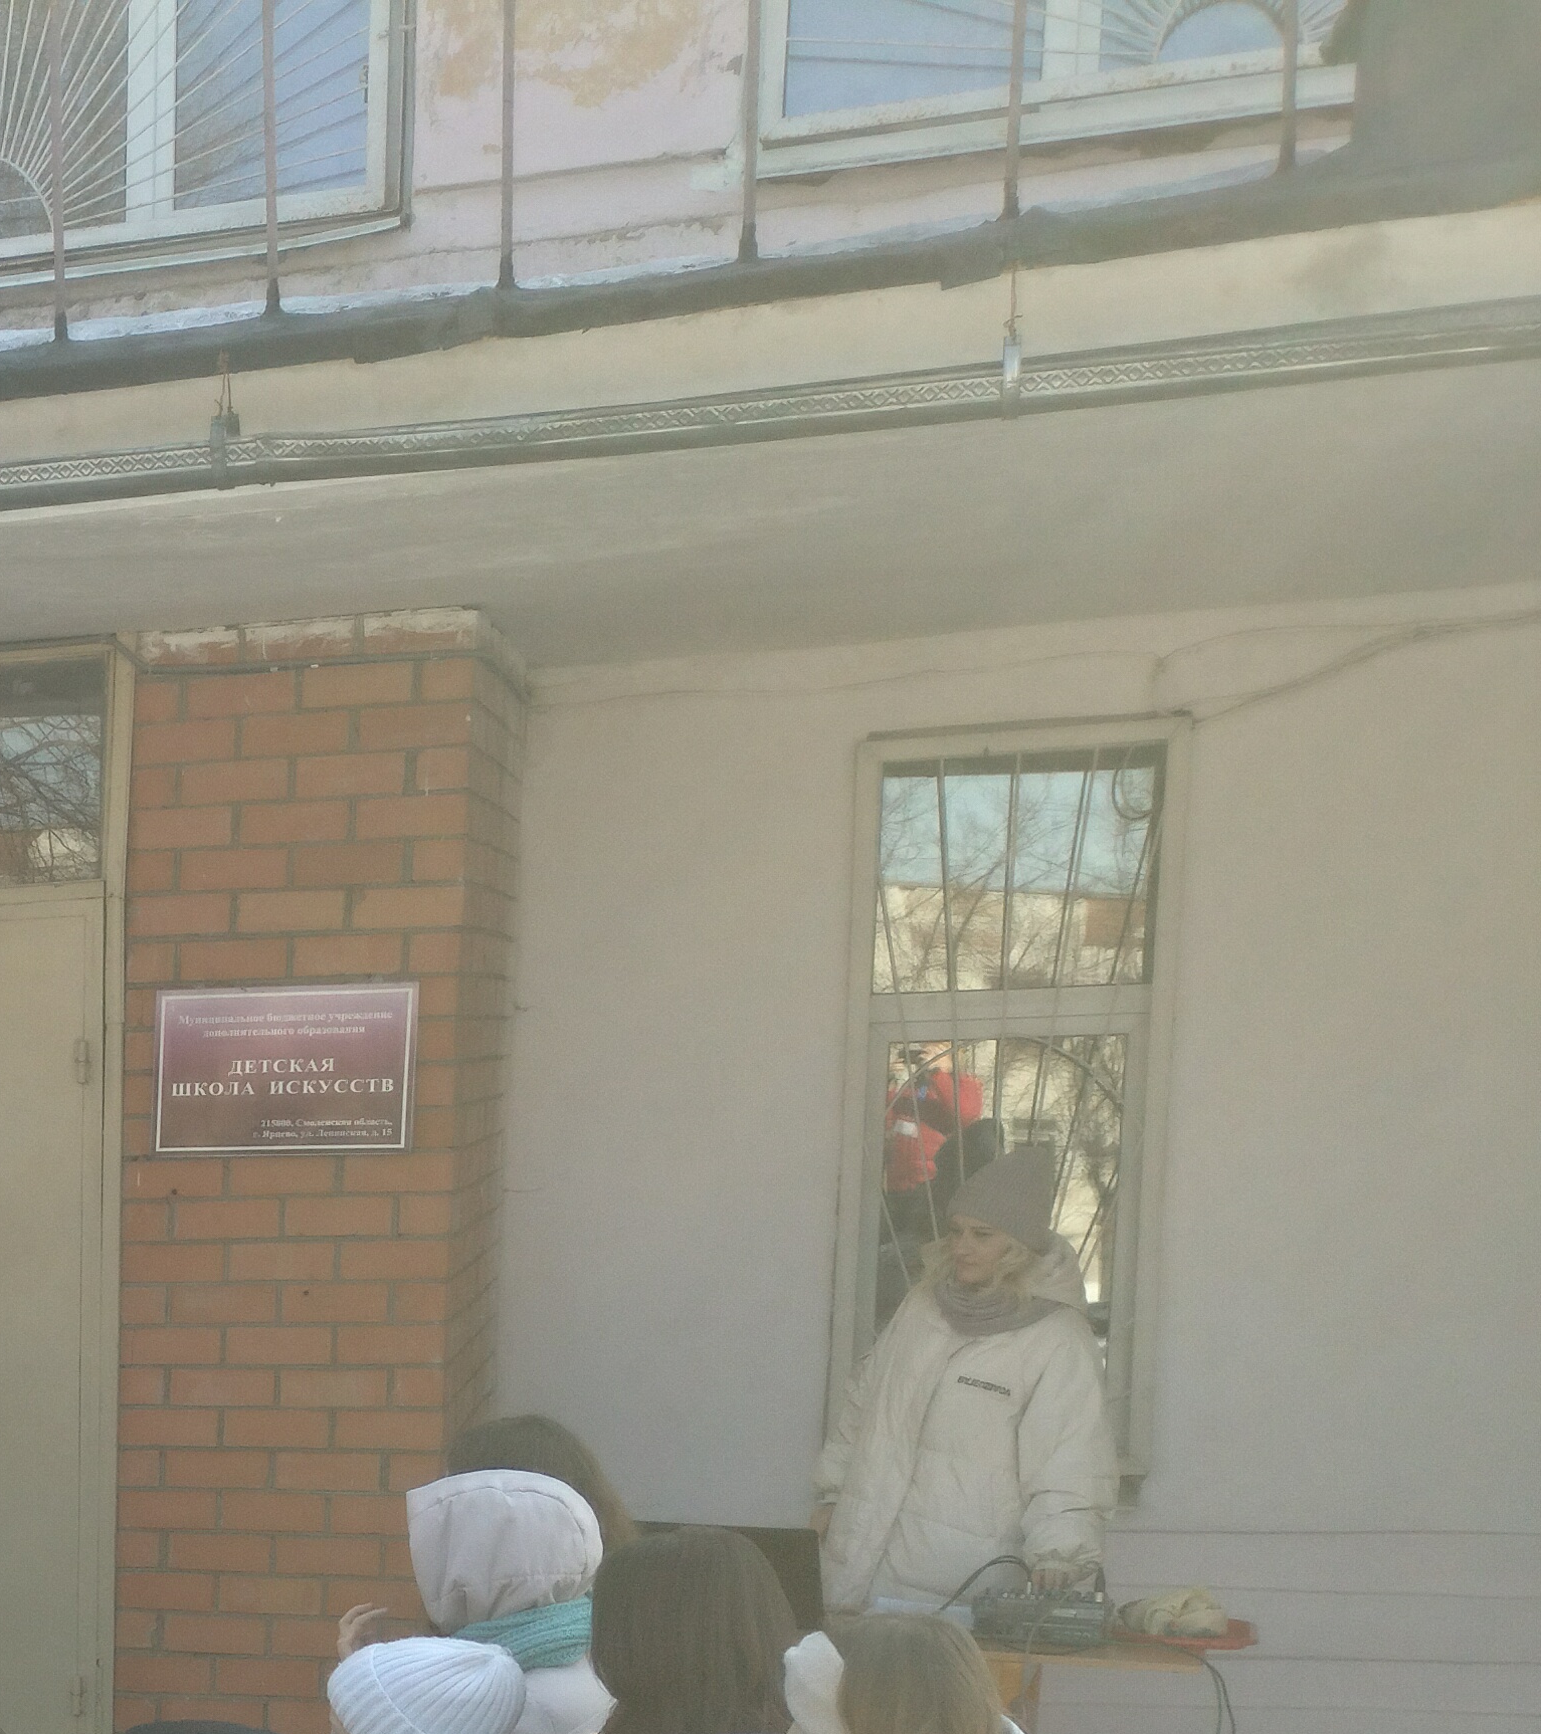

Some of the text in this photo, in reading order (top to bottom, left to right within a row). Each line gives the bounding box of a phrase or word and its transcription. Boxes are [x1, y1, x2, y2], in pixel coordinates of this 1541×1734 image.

[227, 1057, 335, 1076] ДЕТСКАЯ
[171, 1078, 394, 1097] ШКОЛА ИСКУССТВ
